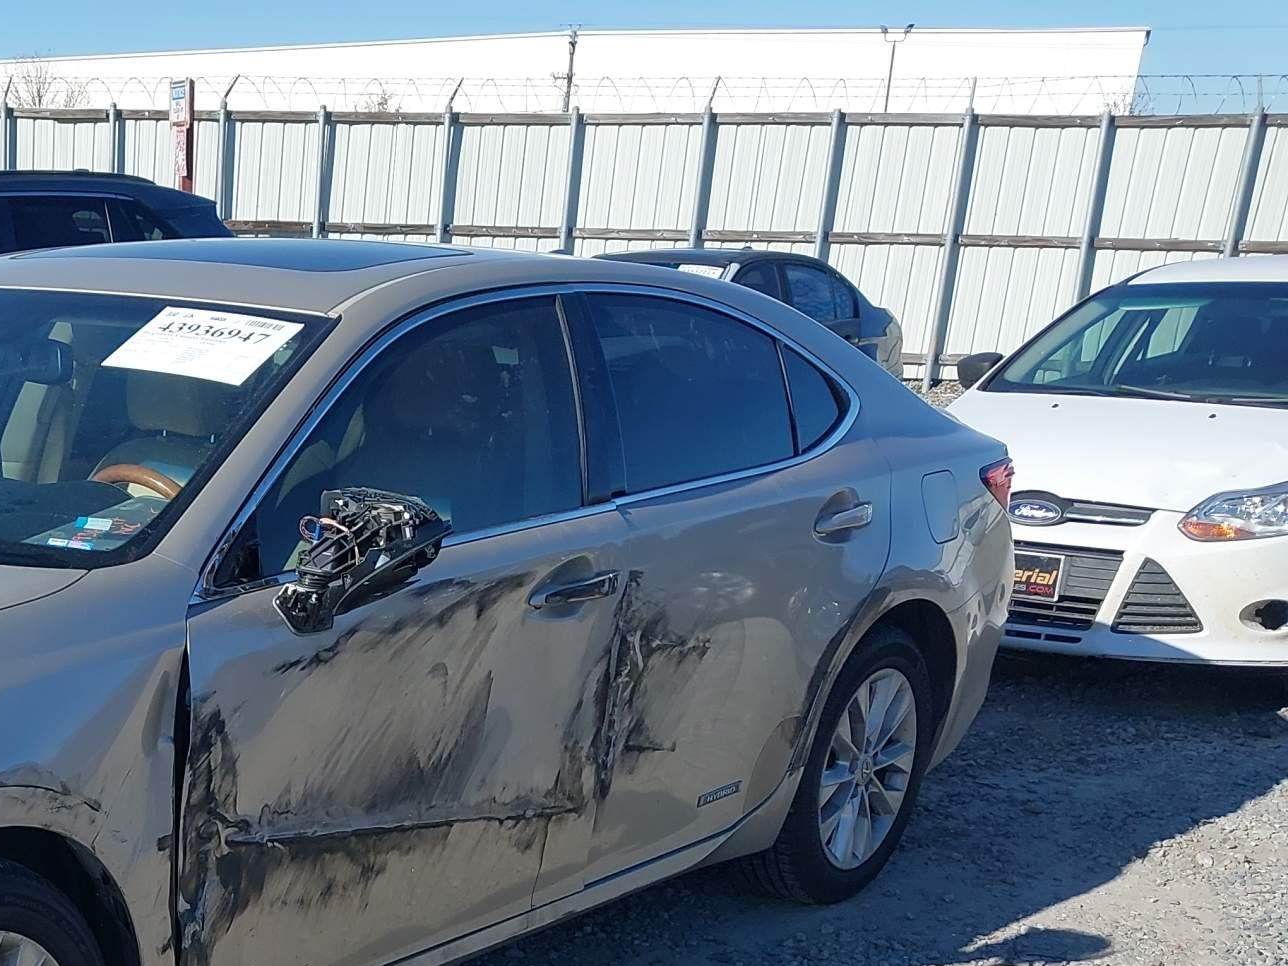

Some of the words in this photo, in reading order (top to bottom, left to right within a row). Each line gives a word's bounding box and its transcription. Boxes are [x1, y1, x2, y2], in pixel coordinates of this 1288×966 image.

[158, 321, 272, 345] 43936947
[1014, 504, 1058, 518] Ford
[707, 786, 736, 802] HYBRID
